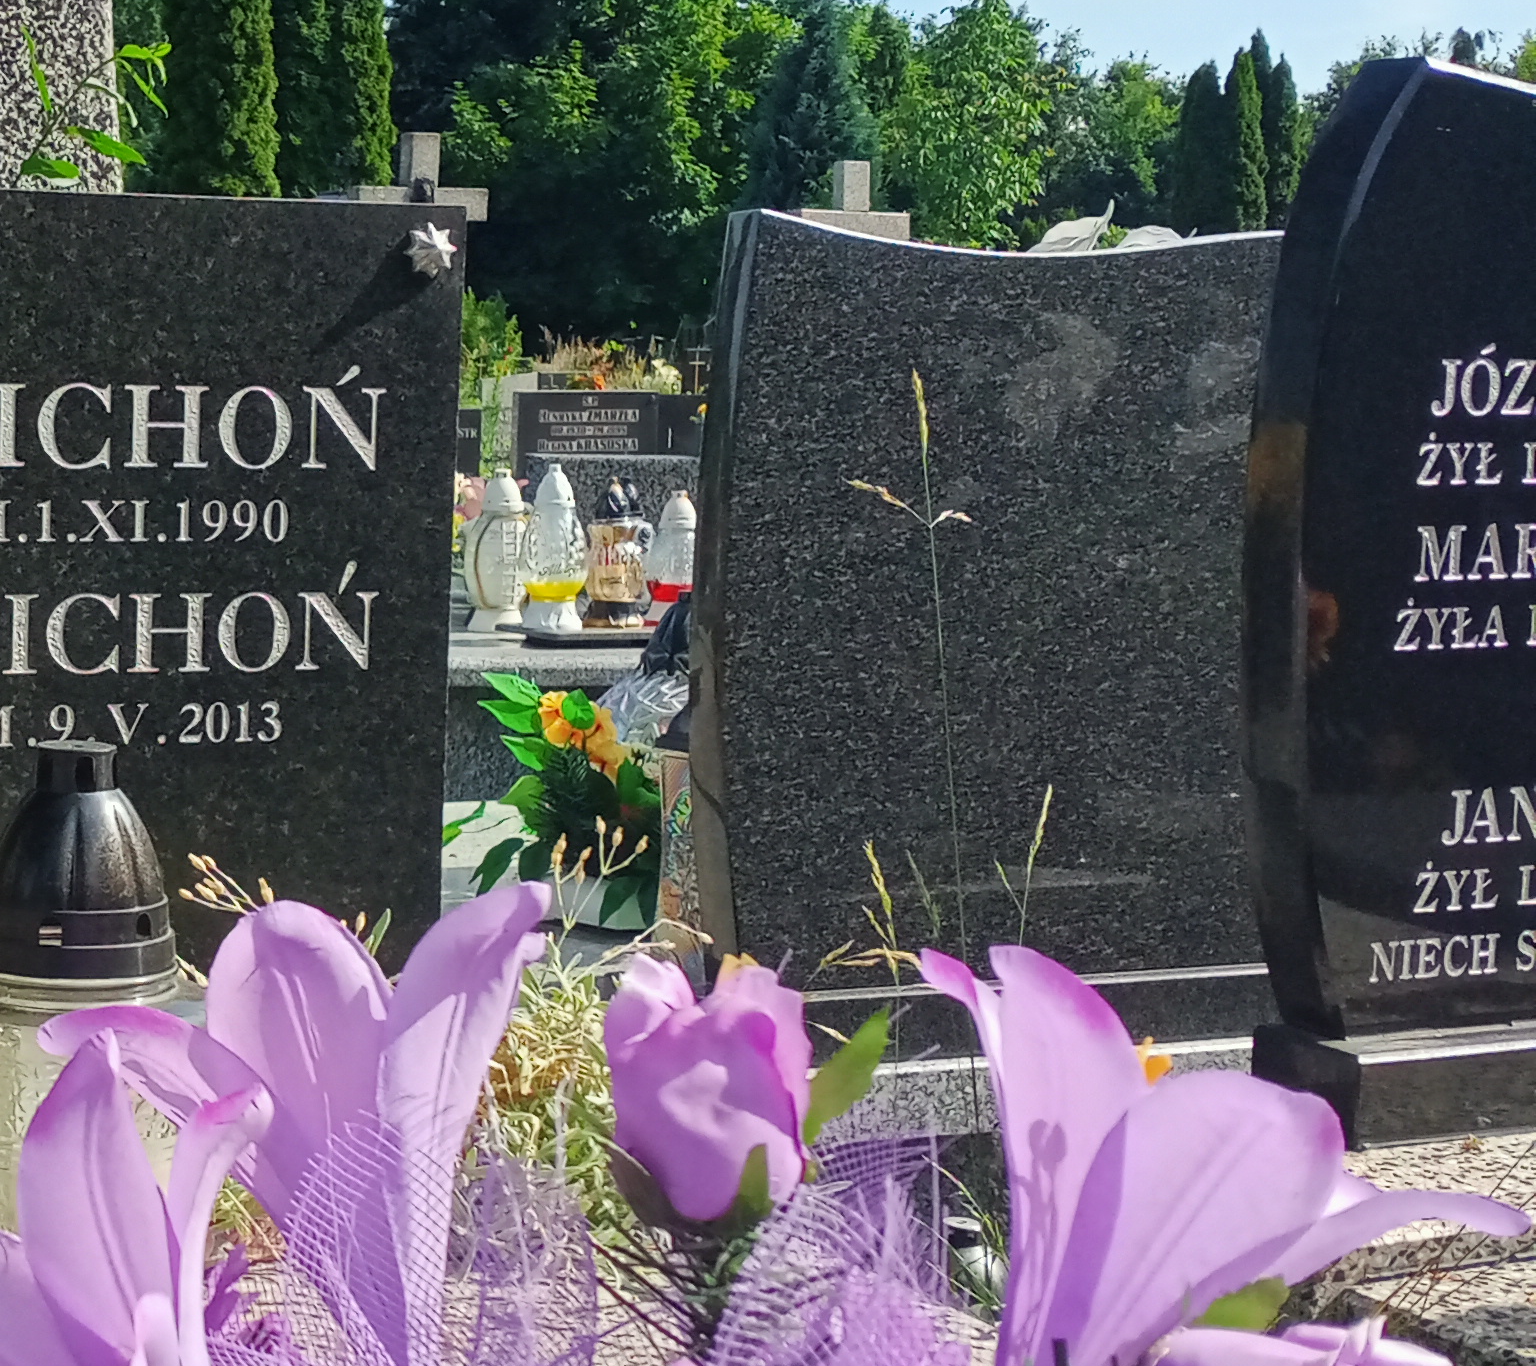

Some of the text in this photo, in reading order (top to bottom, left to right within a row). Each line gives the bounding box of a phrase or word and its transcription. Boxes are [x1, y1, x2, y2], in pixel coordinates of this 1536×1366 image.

[1416, 431, 1503, 487] ŻYŁ
[1393, 597, 1509, 652] ŻYŁA
[1412, 860, 1499, 914] ŻYŁ
[1368, 933, 1501, 984] NIECH
